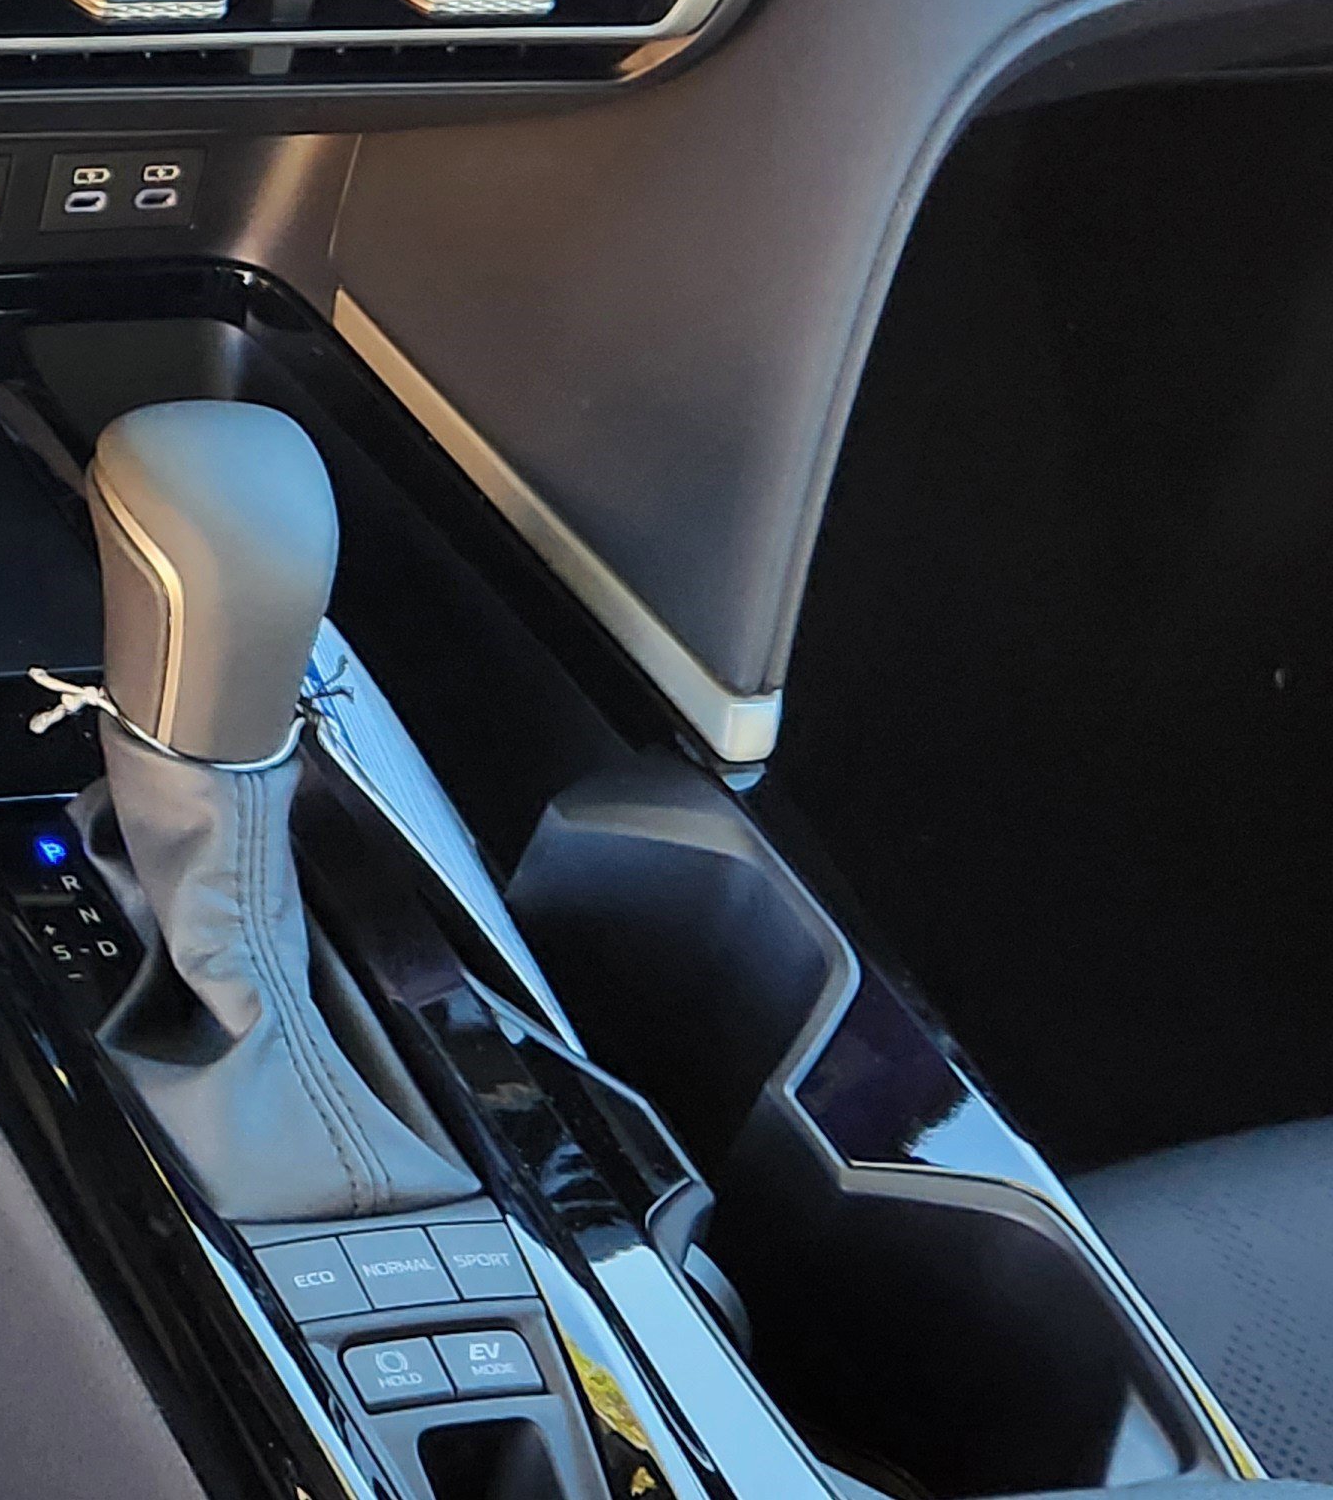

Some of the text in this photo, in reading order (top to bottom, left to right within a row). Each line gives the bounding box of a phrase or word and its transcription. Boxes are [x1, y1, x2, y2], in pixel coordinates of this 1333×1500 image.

[39, 839, 66, 864] P
[61, 875, 82, 891] R
[78, 907, 101, 924] N
[52, 944, 72, 961] S
[97, 940, 118, 956] D
[362, 1257, 436, 1277] NORMAL
[453, 1253, 510, 1269] SPORT
[294, 1270, 336, 1289] ECO
[469, 1343, 500, 1361] EV
[472, 1362, 517, 1376] MODE
[378, 1373, 423, 1389] HOLD
